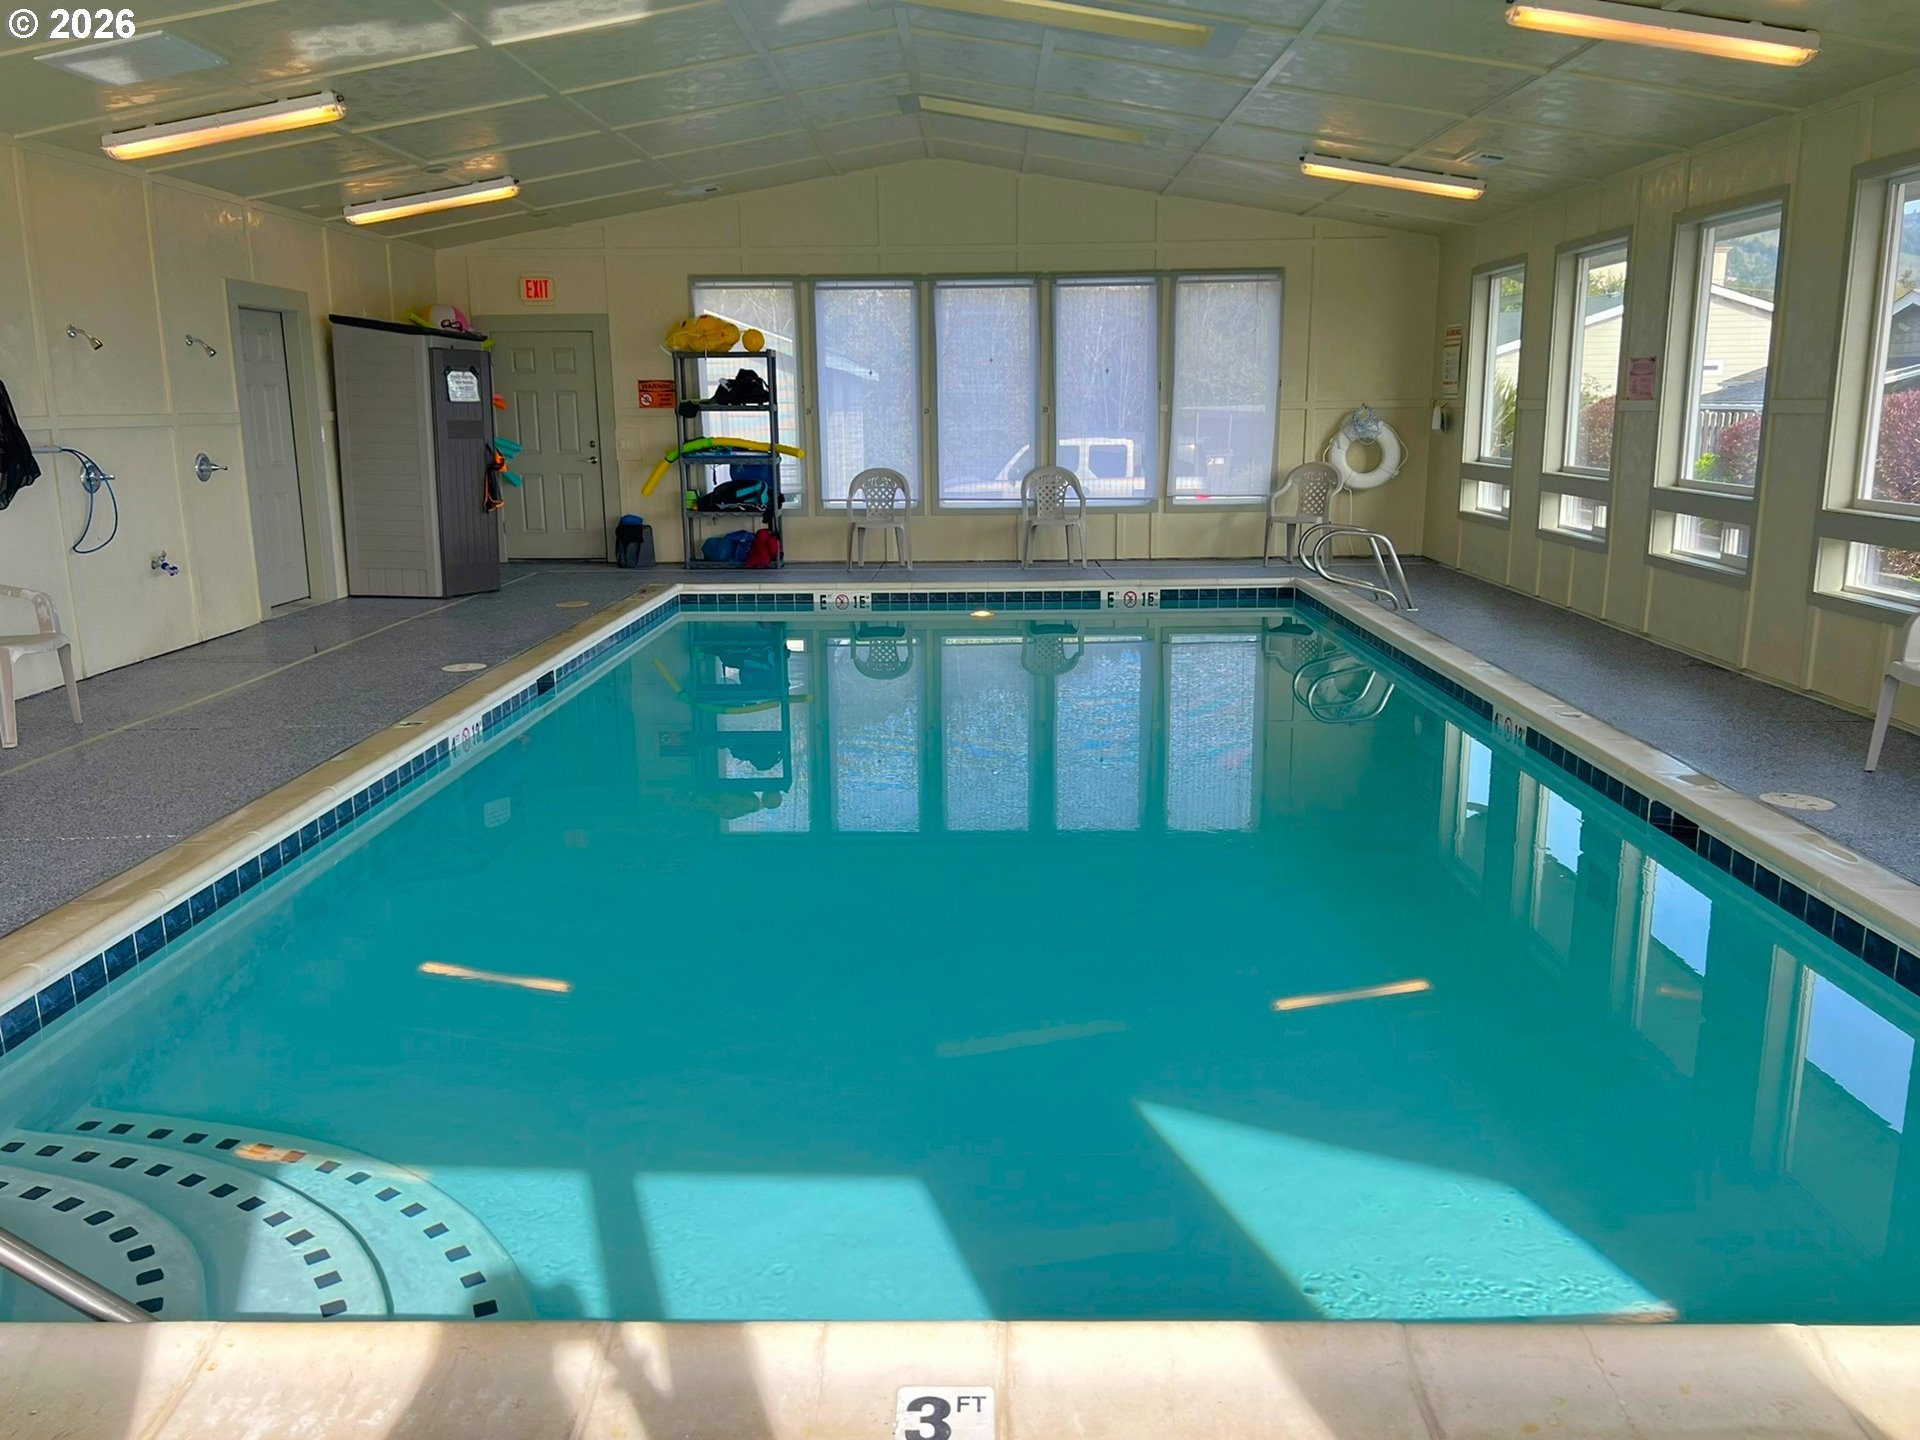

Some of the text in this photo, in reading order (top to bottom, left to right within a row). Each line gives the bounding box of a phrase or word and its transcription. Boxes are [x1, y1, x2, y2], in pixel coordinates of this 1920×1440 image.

[525, 279, 549, 299] EXIT
[904, 1395, 987, 1440] 3 FT
